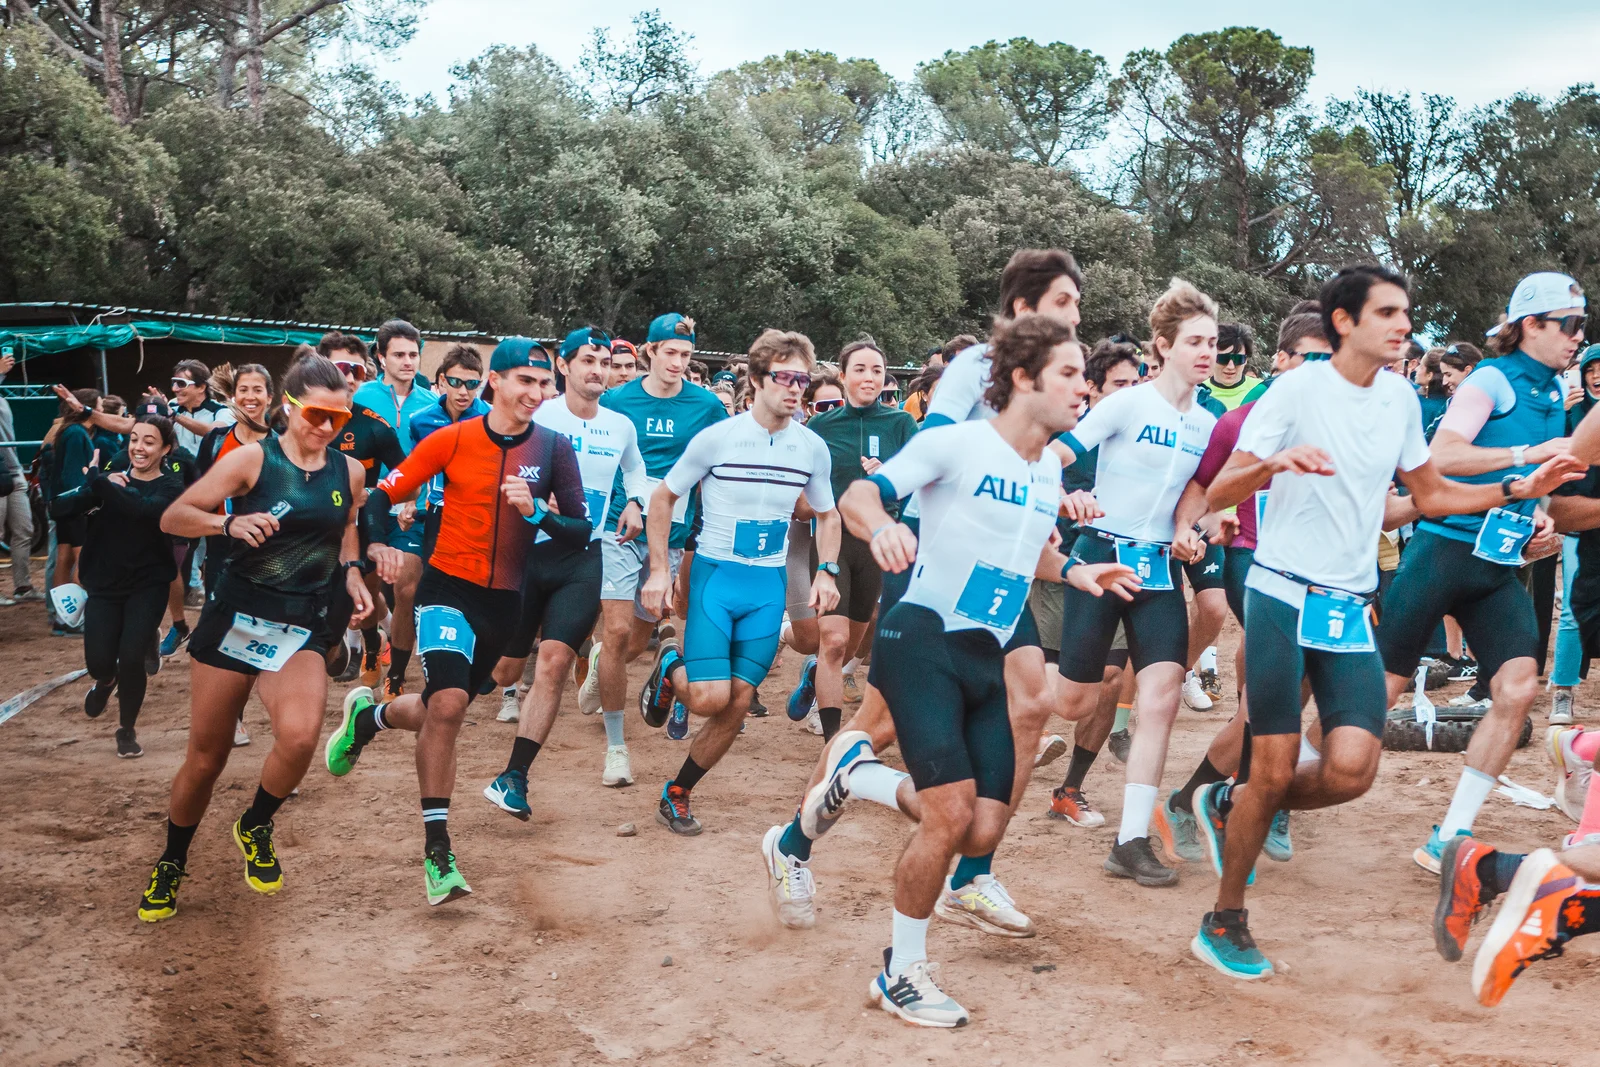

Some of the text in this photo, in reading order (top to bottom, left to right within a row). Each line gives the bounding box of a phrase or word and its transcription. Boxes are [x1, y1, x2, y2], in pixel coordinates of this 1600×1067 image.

[646, 417, 675, 433] FAR
[757, 538, 767, 551] 3
[1137, 562, 1151, 579] 50
[987, 595, 1003, 616] 2
[439, 625, 458, 641] 78
[1327, 618, 1345, 639] 19
[245, 639, 279, 659] 266
